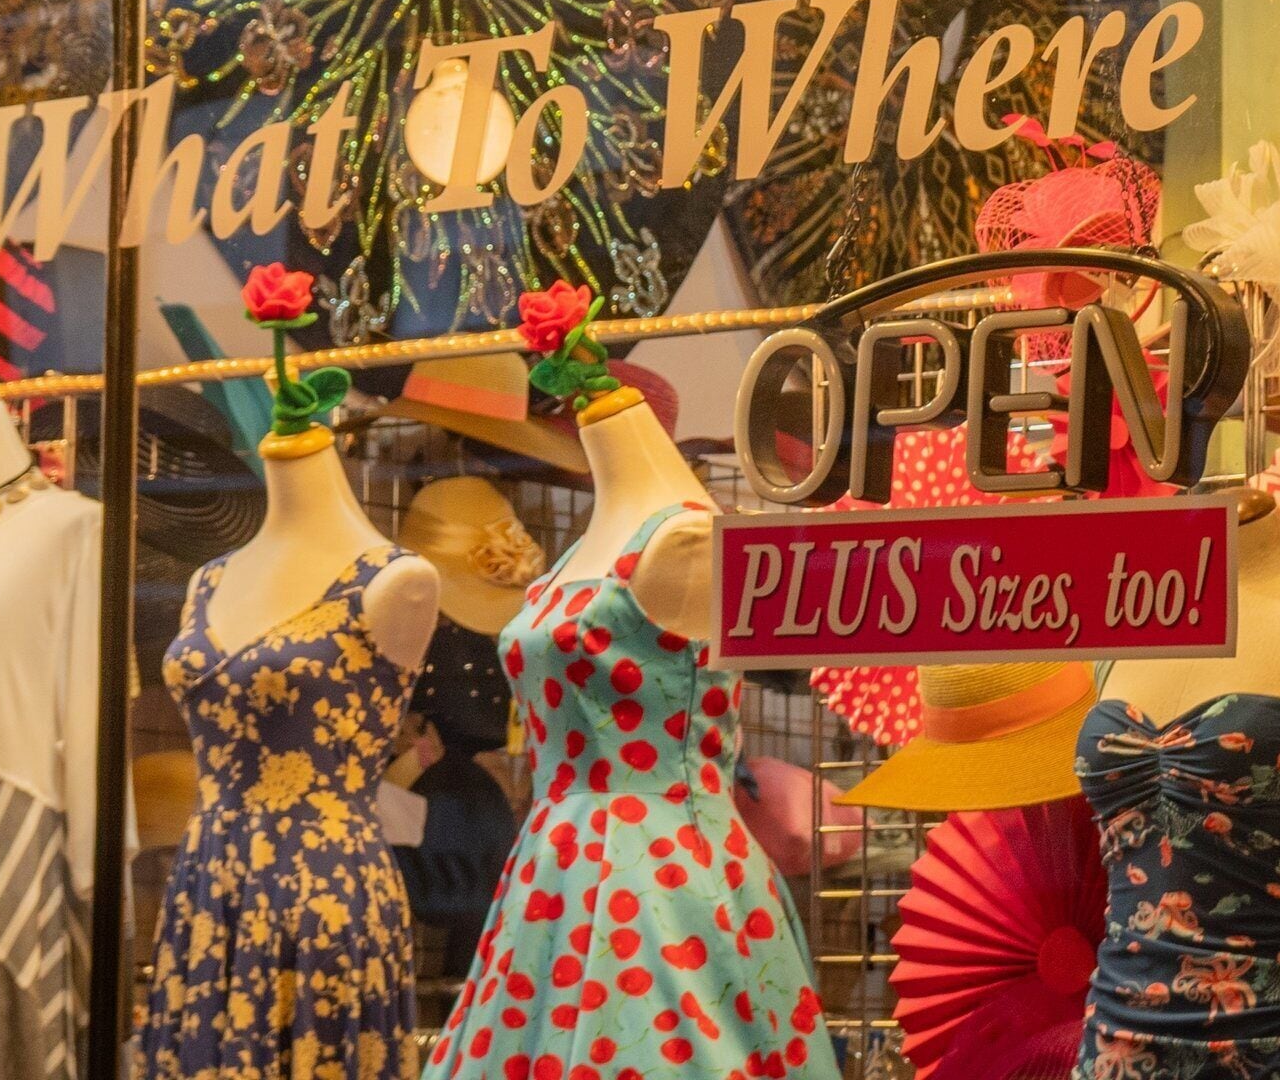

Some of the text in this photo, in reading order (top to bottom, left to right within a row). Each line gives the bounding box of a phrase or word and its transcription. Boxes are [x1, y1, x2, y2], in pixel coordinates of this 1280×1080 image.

[414, 22, 588, 213] To
[734, 303, 1188, 504] OPEN
[728, 536, 1212, 645] PLUS Sizes, too!
